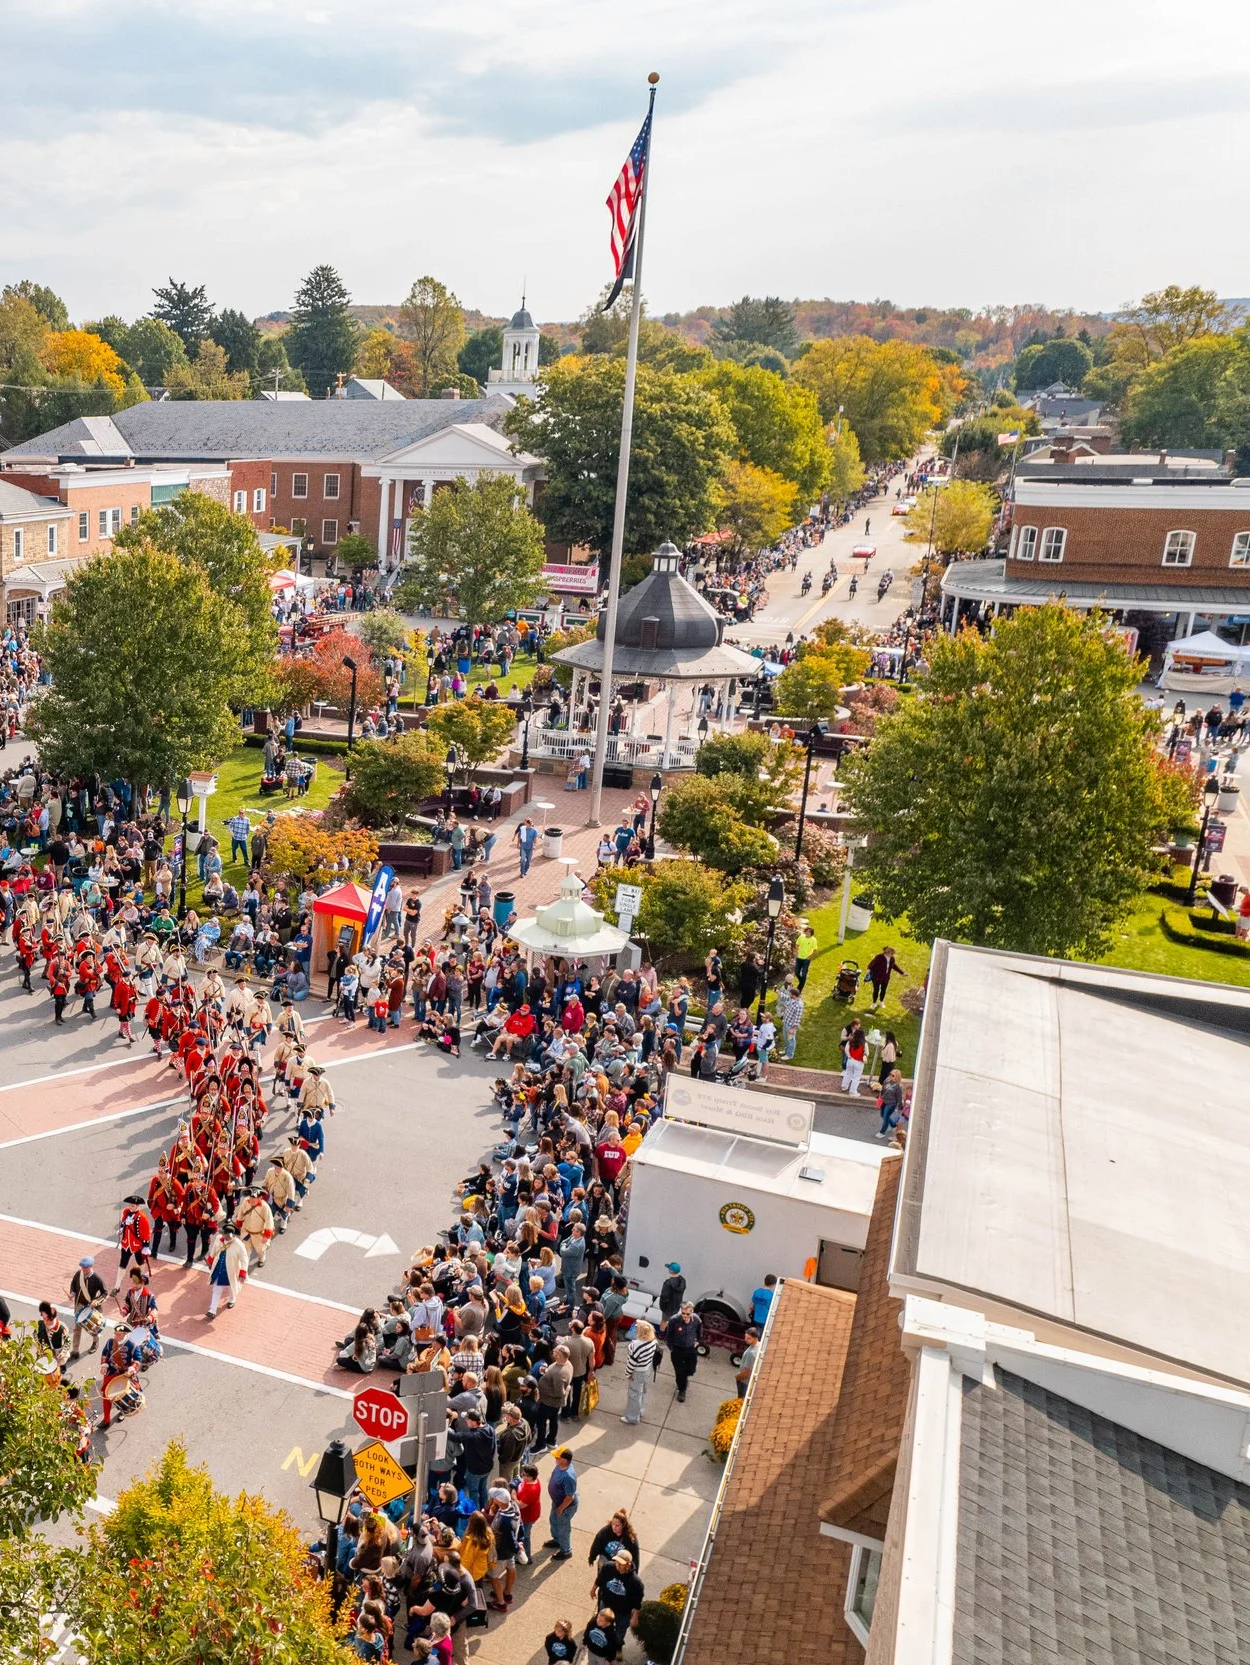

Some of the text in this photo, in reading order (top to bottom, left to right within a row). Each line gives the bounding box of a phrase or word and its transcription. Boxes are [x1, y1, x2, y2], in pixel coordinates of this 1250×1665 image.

[355, 1400, 406, 1430] STOP
[367, 1450, 389, 1464] LOOK
[353, 1459, 402, 1481] BOTH WAYS
[369, 1475, 386, 1487] FOR
[365, 1487, 387, 1499] PEDS
